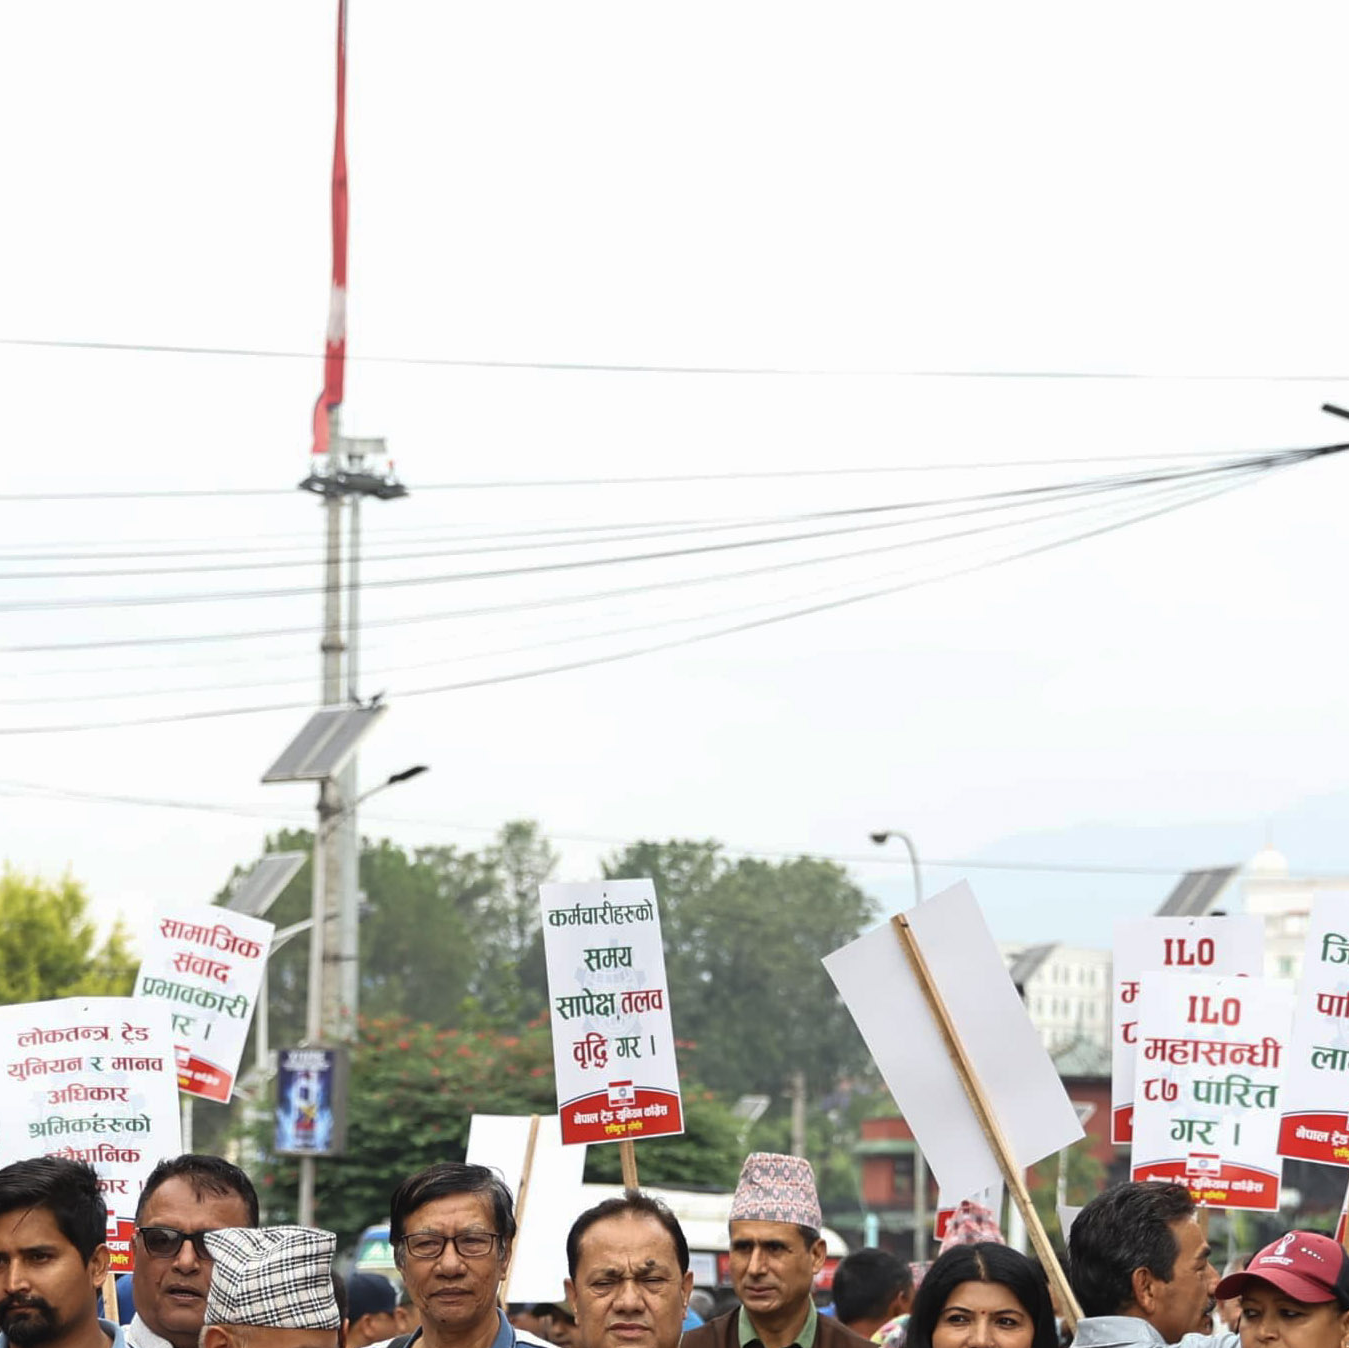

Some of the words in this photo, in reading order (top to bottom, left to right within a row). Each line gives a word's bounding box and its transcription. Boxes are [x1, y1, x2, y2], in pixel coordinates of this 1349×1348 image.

[159, 917, 263, 959] सामाजिक
[583, 946, 633, 972] समय
[1164, 938, 1215, 966] ILO
[173, 951, 233, 984] संवाद
[141, 976, 250, 1019] प्रभावकारी
[620, 988, 664, 1015] तलव
[1188, 995, 1241, 1027] ILO
[121, 1022, 150, 1045] ट्रेड
[616, 1036, 641, 1060] गर
[1145, 1037, 1283, 1069] महासन्धी
[7, 1057, 84, 1081] युनियन
[90, 1056, 104, 1071] र
[111, 1056, 164, 1072] मानव
[47, 1082, 130, 1105] अधिकार
[1143, 1077, 1179, 1102] ८७
[1192, 1073, 1280, 1109] पारित
[1171, 1119, 1218, 1145] गर
